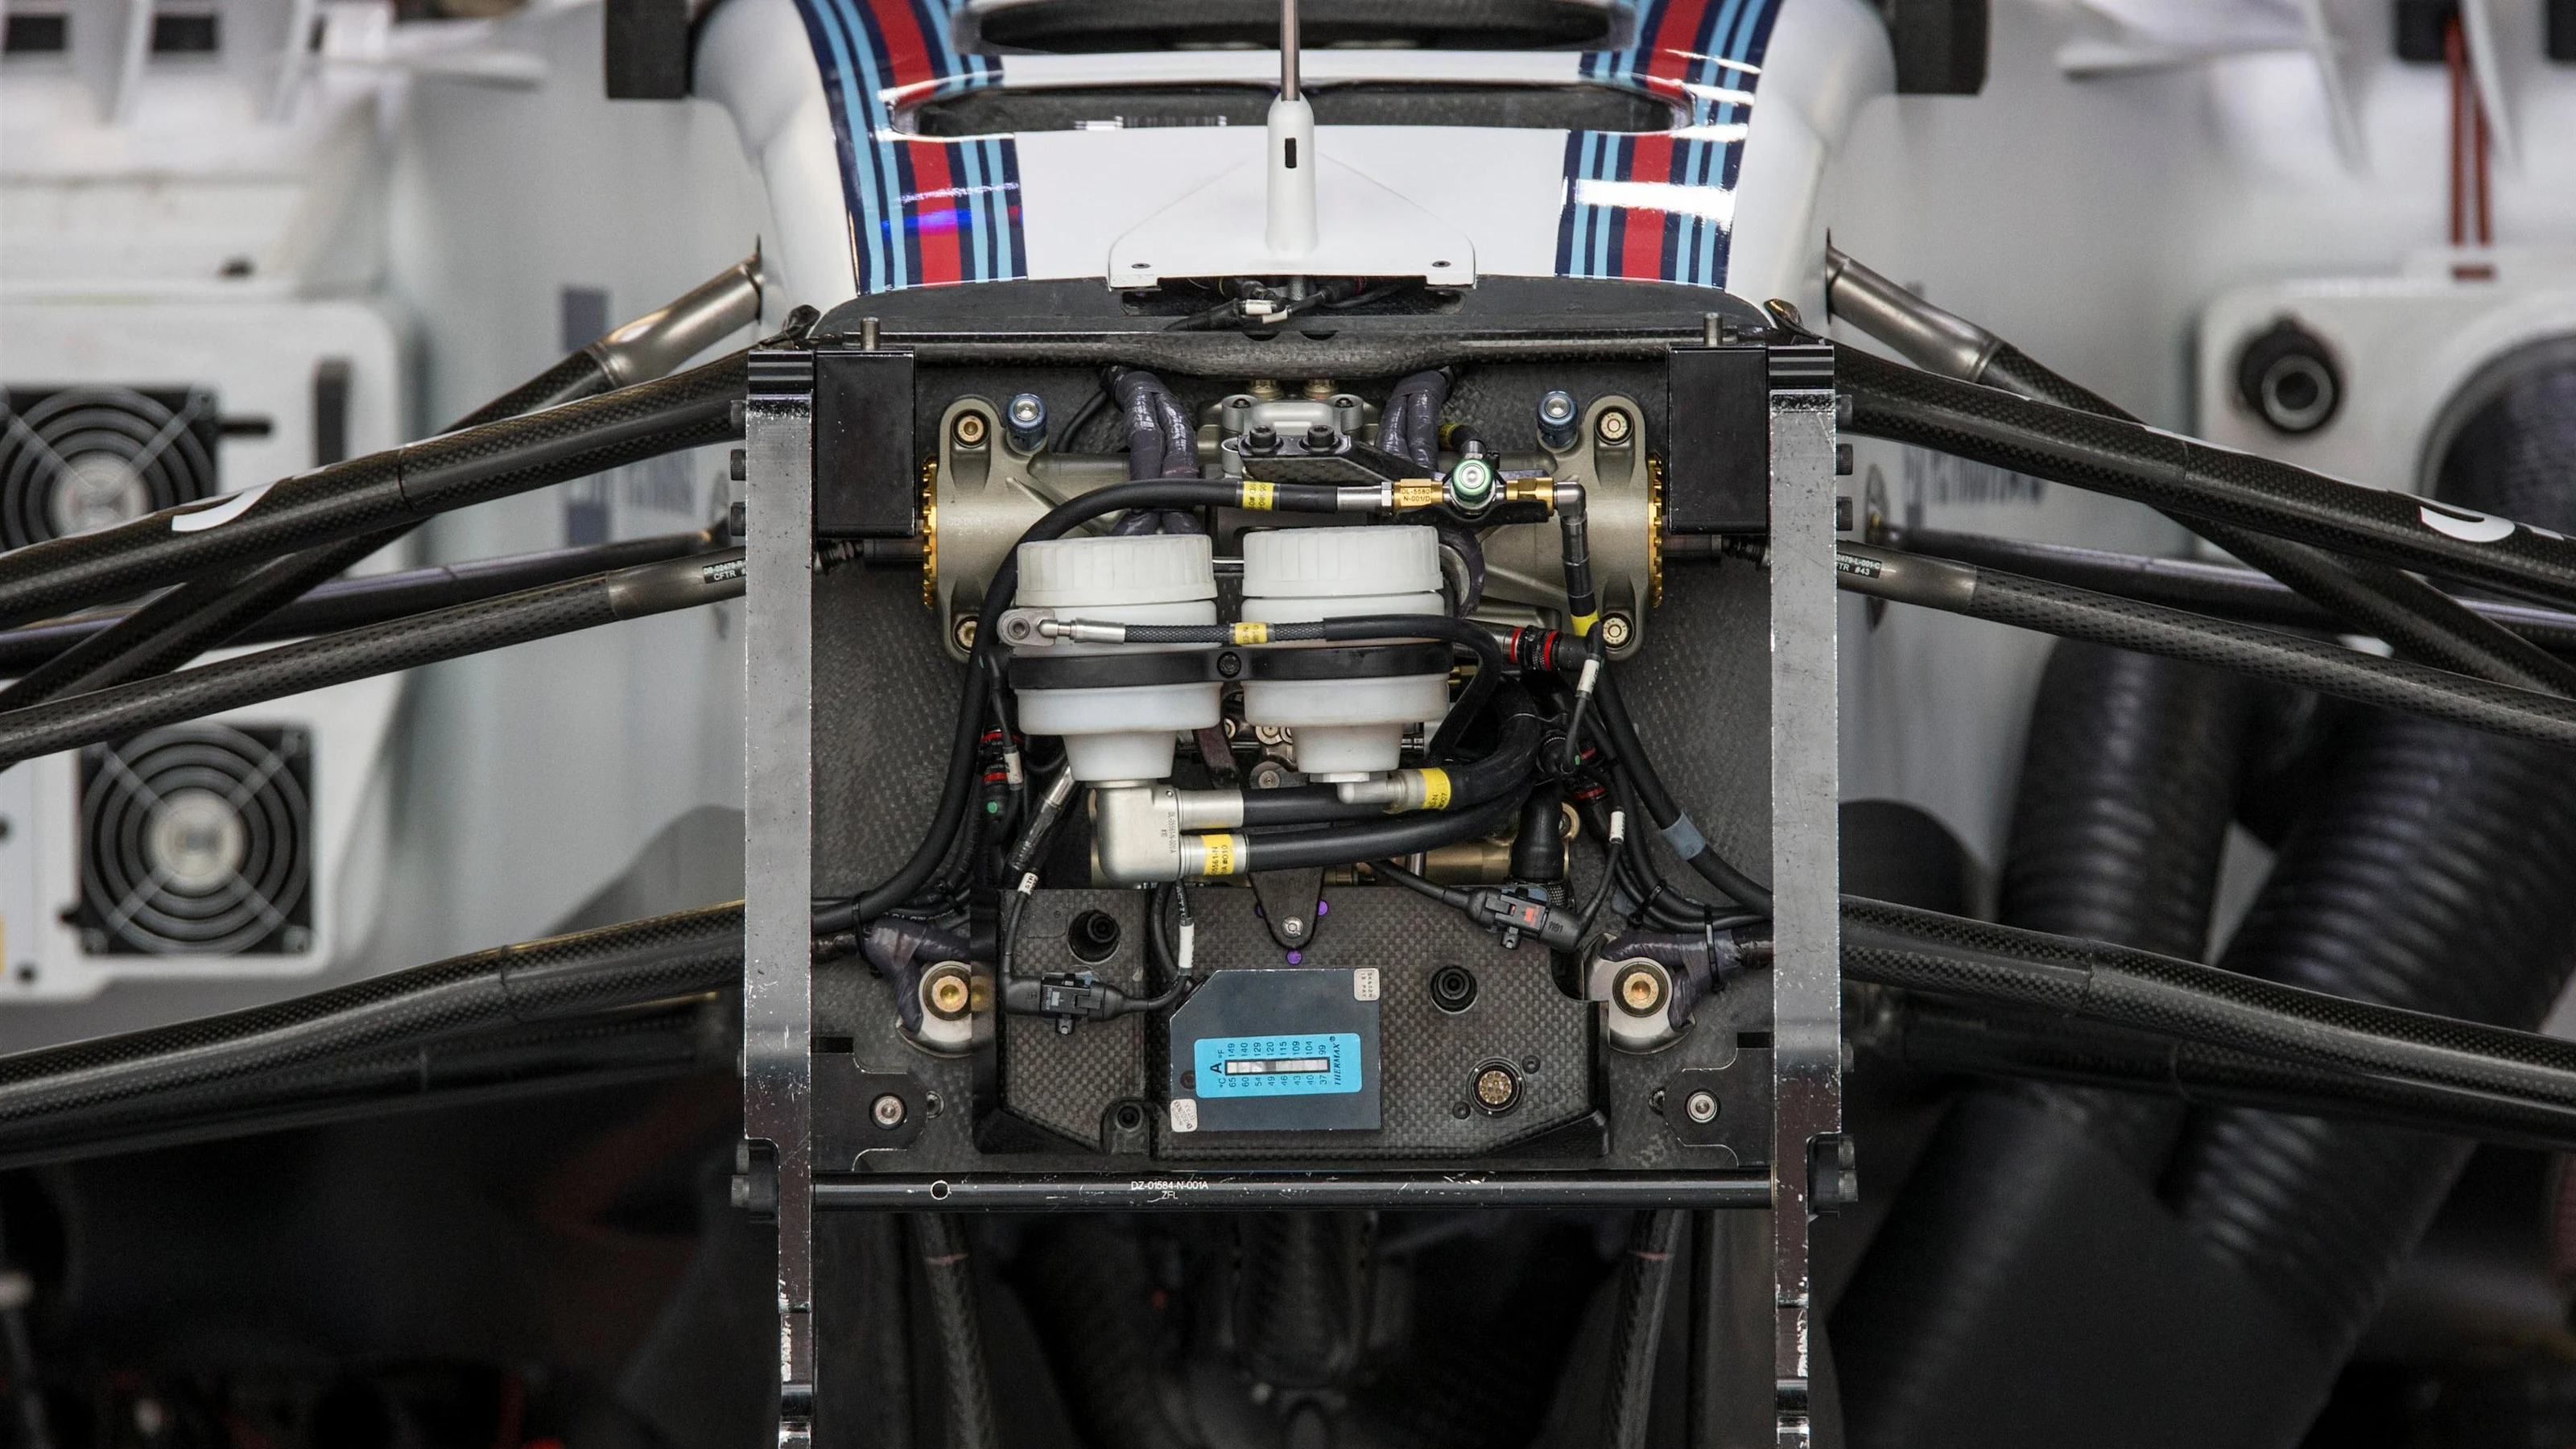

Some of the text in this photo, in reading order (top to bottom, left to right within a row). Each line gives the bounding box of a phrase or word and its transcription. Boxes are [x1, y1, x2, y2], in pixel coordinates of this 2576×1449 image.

[713, 570, 737, 580] CFTR
[1855, 567, 1870, 576] #43
[1025, 874, 1034, 890] STR
[1210, 1063, 1222, 1074] A
[1266, 1042, 1275, 1086] 49 120
[1319, 1044, 1327, 1085] 37 99
[1229, 1077, 1236, 1088] 65
[1241, 1077, 1249, 1088] 60
[1255, 1077, 1262, 1086] 54
[1281, 1075, 1288, 1086] 46
[1294, 1075, 1301, 1085] 43
[1307, 1075, 1314, 1085] 40
[1131, 1181, 1208, 1190] DZ-01584-N-001A
[1162, 1191, 1179, 1199] ZFL
